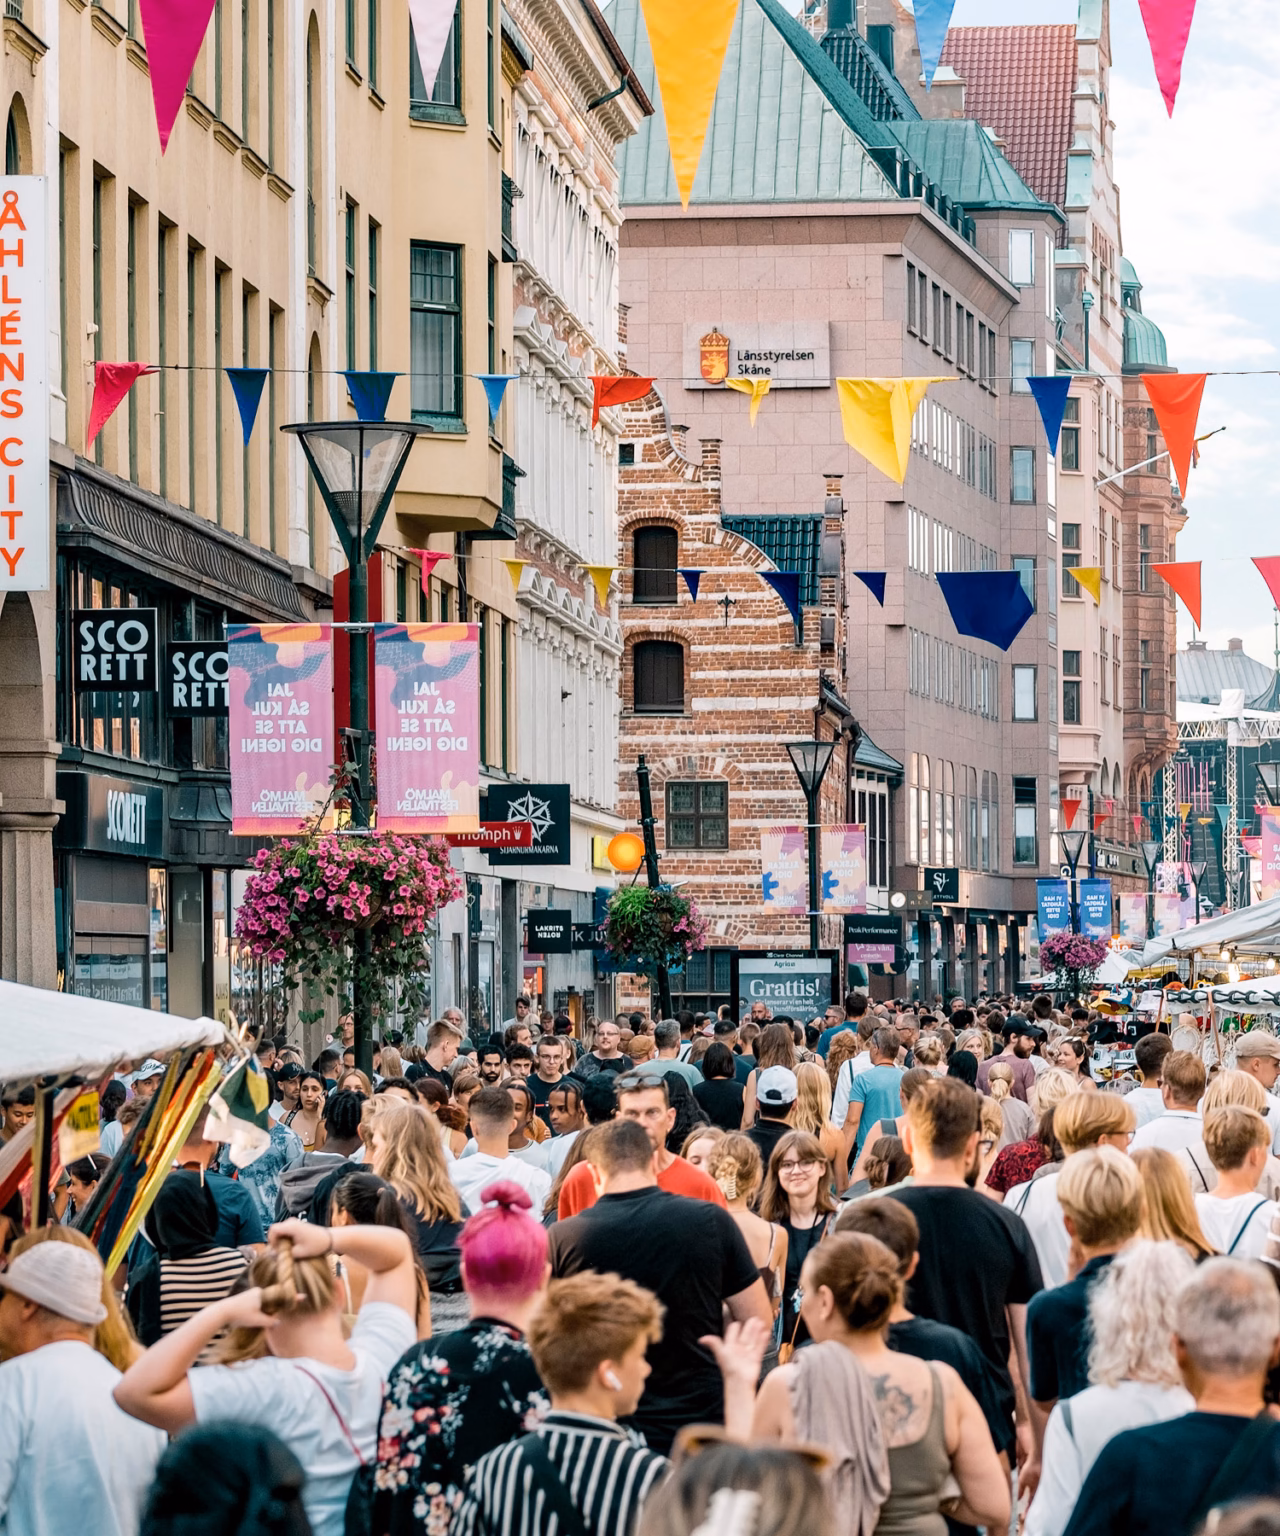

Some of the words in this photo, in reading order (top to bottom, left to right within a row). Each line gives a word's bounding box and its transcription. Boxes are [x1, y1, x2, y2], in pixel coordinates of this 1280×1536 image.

[0, 190, 27, 419] ÅHLÉNS
[737, 350, 815, 363] Länsstyrelsen
[737, 364, 771, 376] Skåne
[0, 437, 26, 577] CITY
[79, 619, 149, 652] SCO
[80, 653, 148, 681] RETT
[172, 651, 228, 681] SCO
[106, 789, 147, 845] SCORETT
[749, 977, 820, 997] Grattis!
